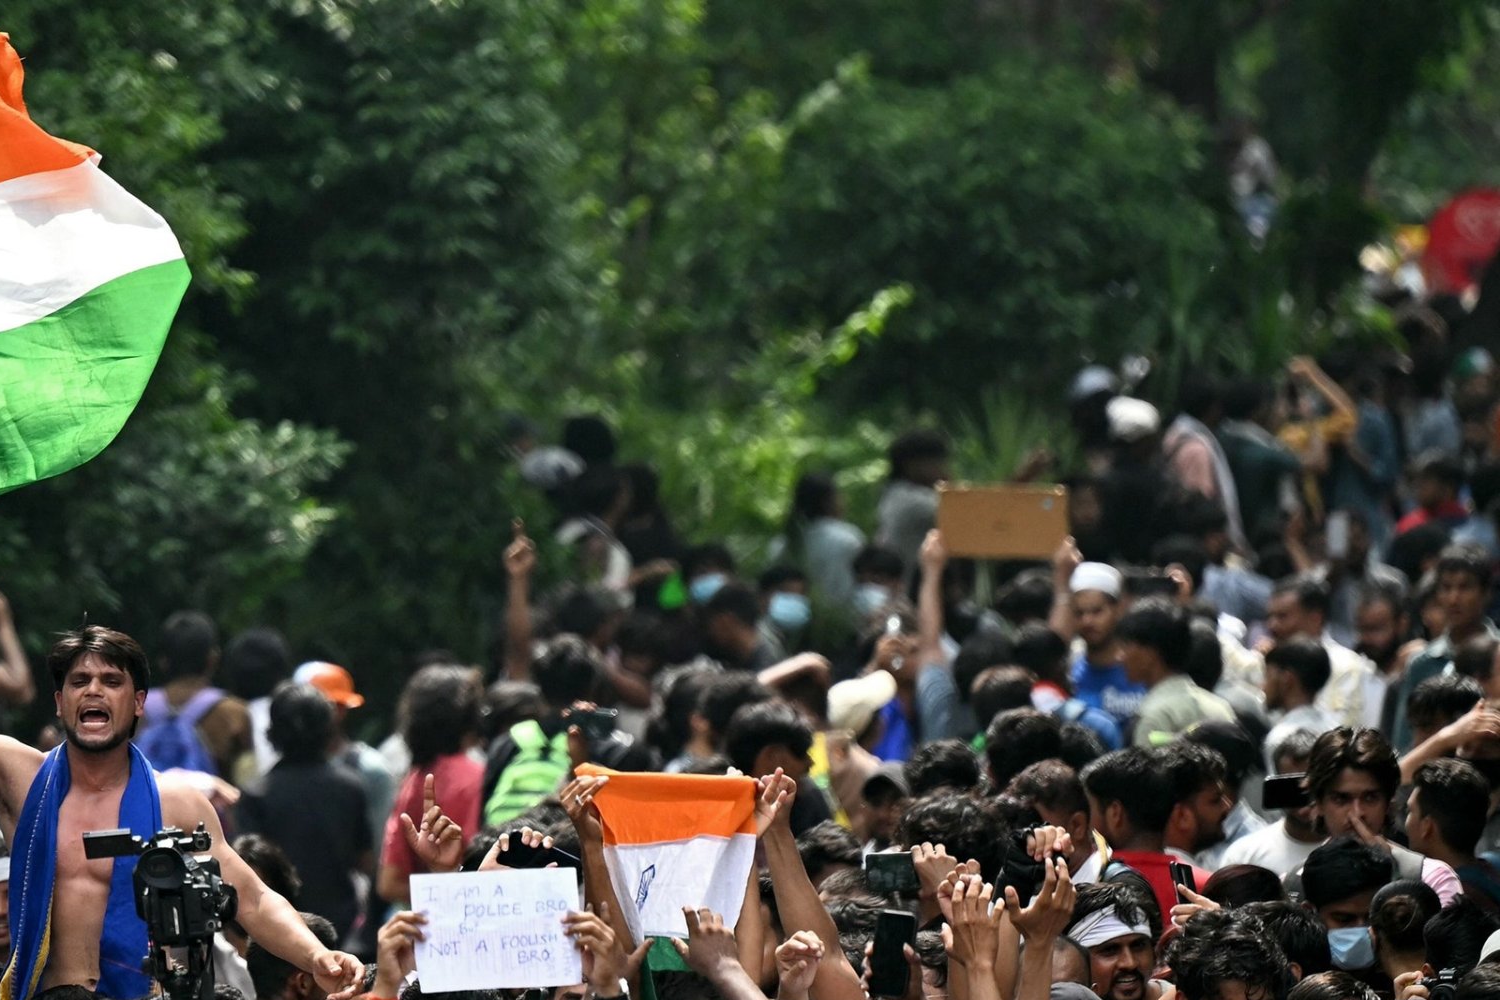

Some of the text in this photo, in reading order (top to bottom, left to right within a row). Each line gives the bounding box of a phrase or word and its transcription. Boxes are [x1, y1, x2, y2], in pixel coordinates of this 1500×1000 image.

[453, 886, 480, 901] AM
[493, 885, 504, 897] A
[464, 900, 567, 920] POLICE BRO
[429, 940, 461, 958] NOT
[475, 940, 488, 952] A
[501, 933, 557, 950] FOOLISH
[517, 949, 550, 964] BRO
